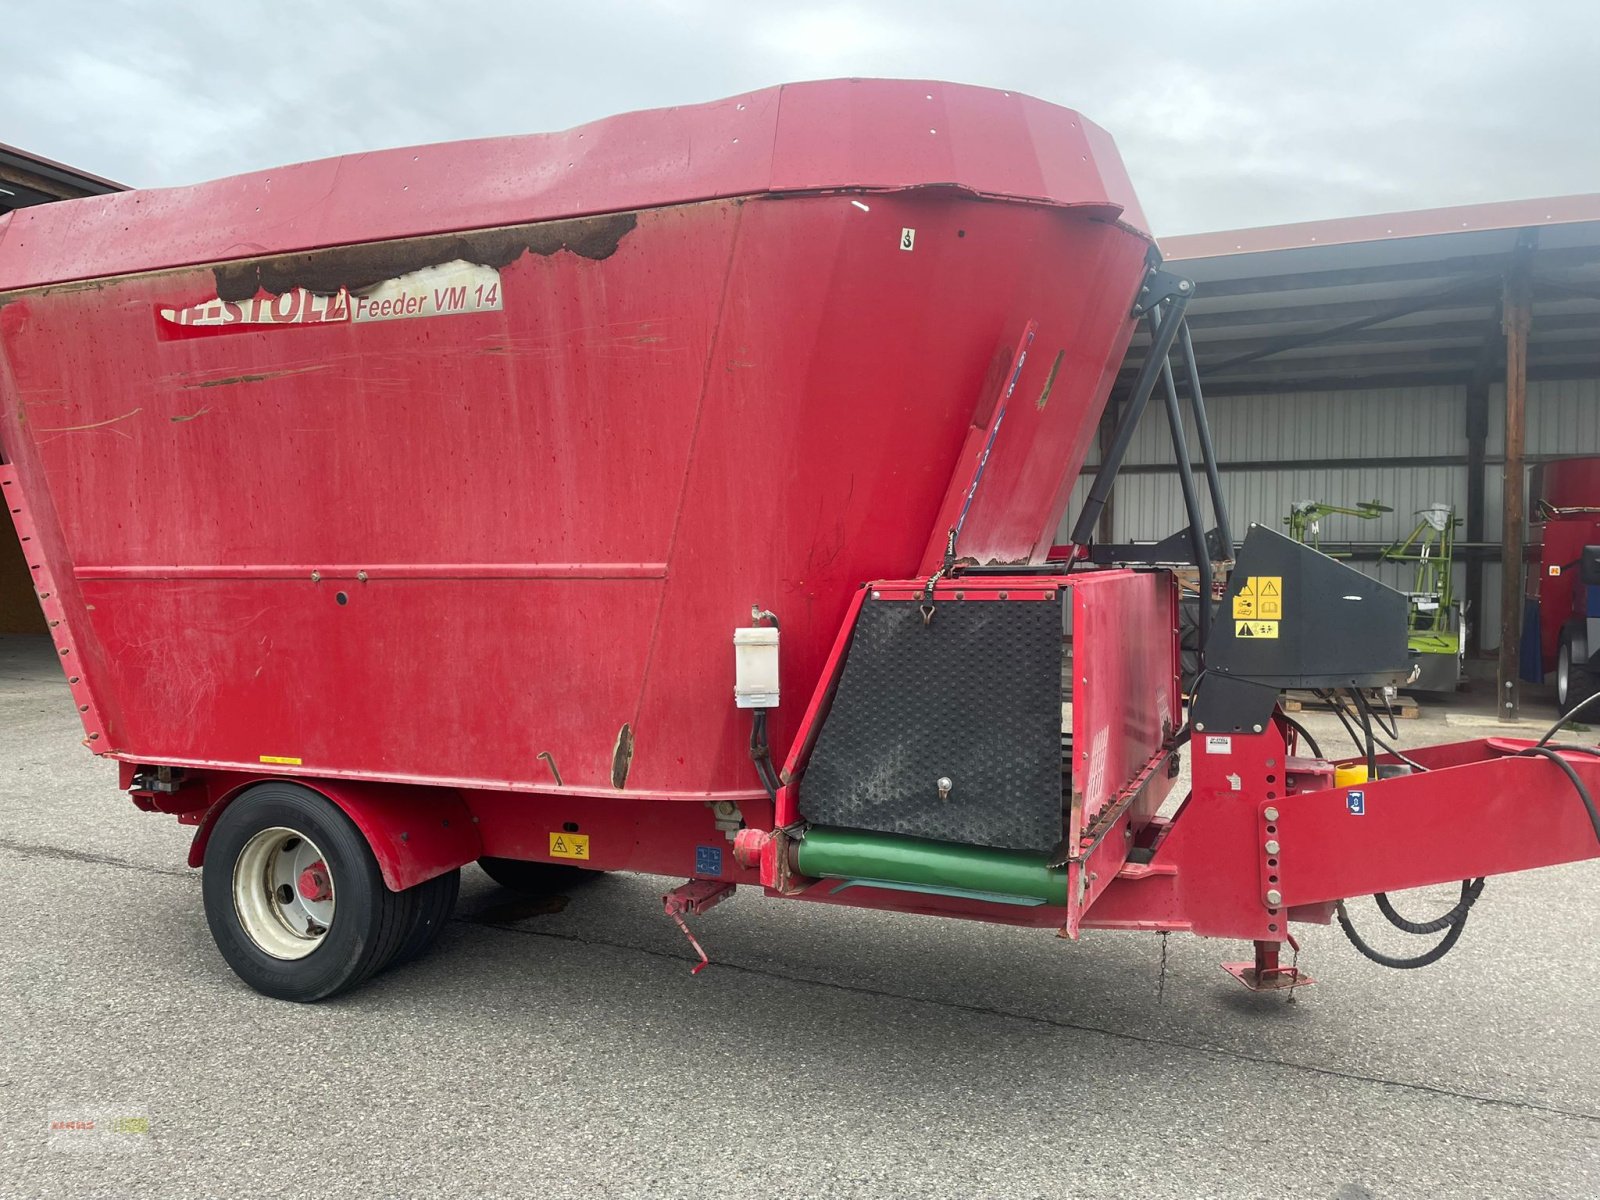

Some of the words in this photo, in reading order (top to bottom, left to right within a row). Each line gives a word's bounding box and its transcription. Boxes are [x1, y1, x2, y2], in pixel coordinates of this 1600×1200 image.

[356, 292, 428, 319] Feeder
[434, 286, 467, 311] VM
[475, 283, 498, 308] 14
